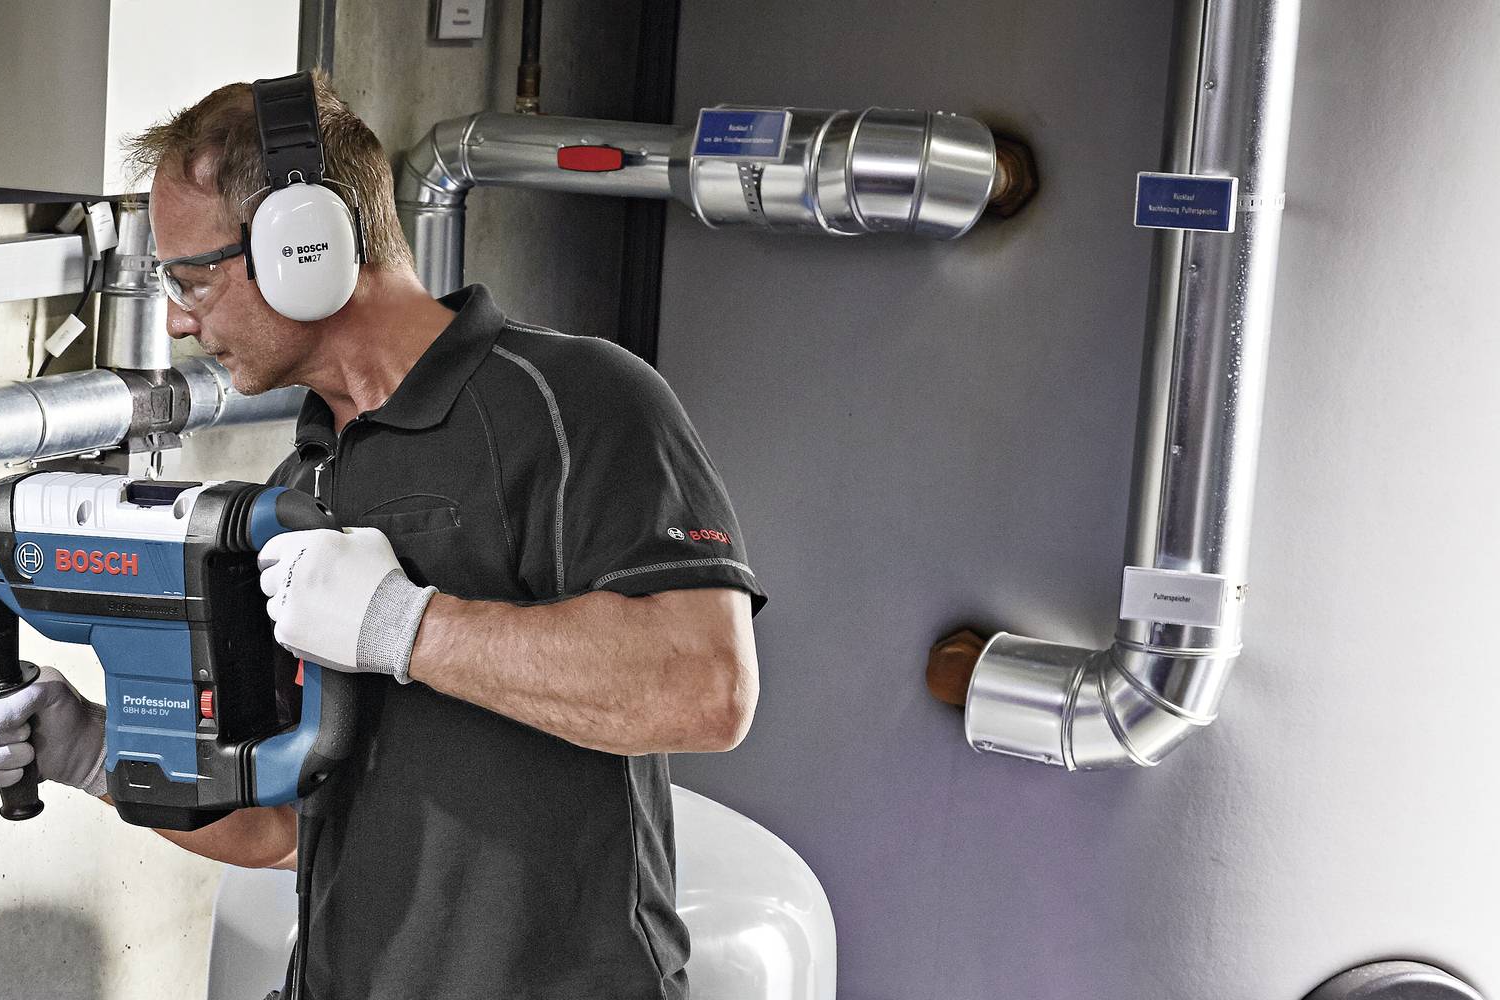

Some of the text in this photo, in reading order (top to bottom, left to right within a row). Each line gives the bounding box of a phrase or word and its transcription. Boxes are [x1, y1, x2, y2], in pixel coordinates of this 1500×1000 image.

[296, 242, 329, 255] BOSCH
[298, 253, 322, 264] EM27
[689, 529, 732, 545] BOSCH
[55, 548, 139, 577] BOSCH
[123, 694, 190, 709] Professional
[122, 705, 170, 716] GBH 8-45 DV
